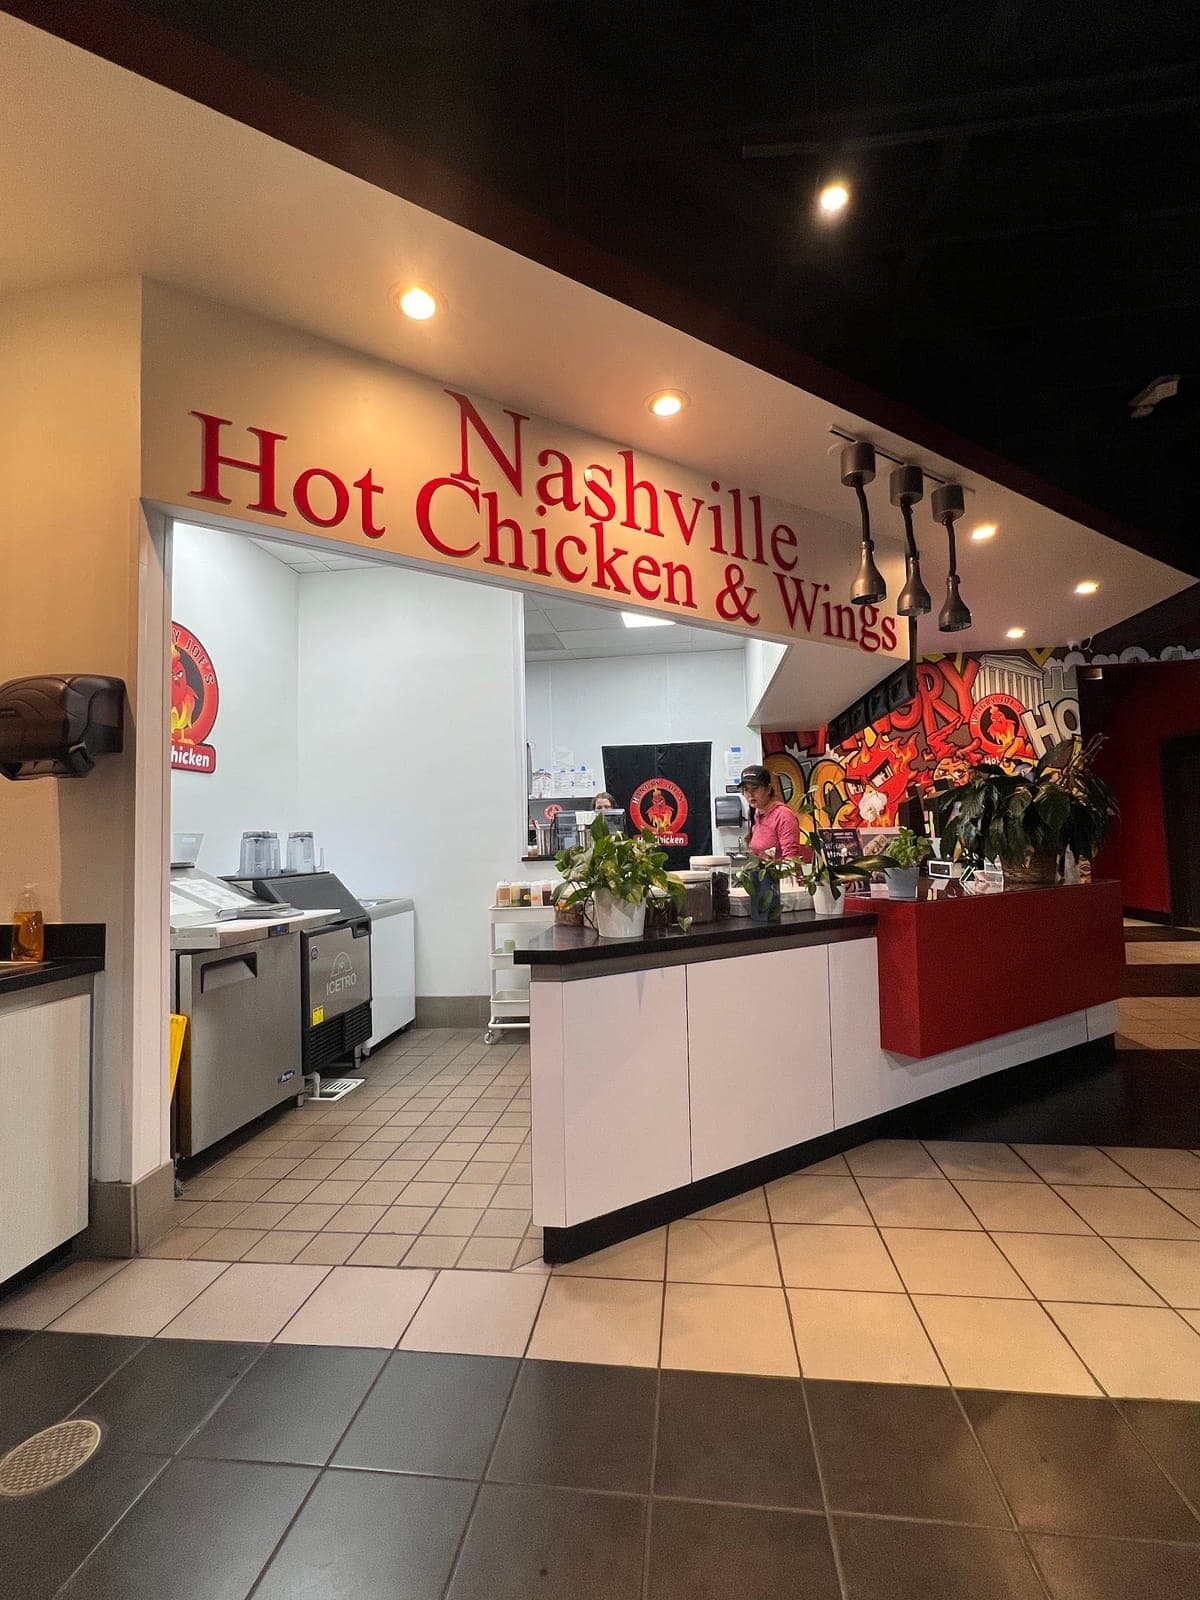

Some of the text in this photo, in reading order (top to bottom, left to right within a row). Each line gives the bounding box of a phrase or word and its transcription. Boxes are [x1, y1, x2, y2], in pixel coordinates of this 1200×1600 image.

[187, 410, 898, 652] Hot Chicken & Wings
[444, 388, 799, 571] Nashville
[170, 745, 210, 768] hicken
[326, 973, 357, 996] ICETRO
